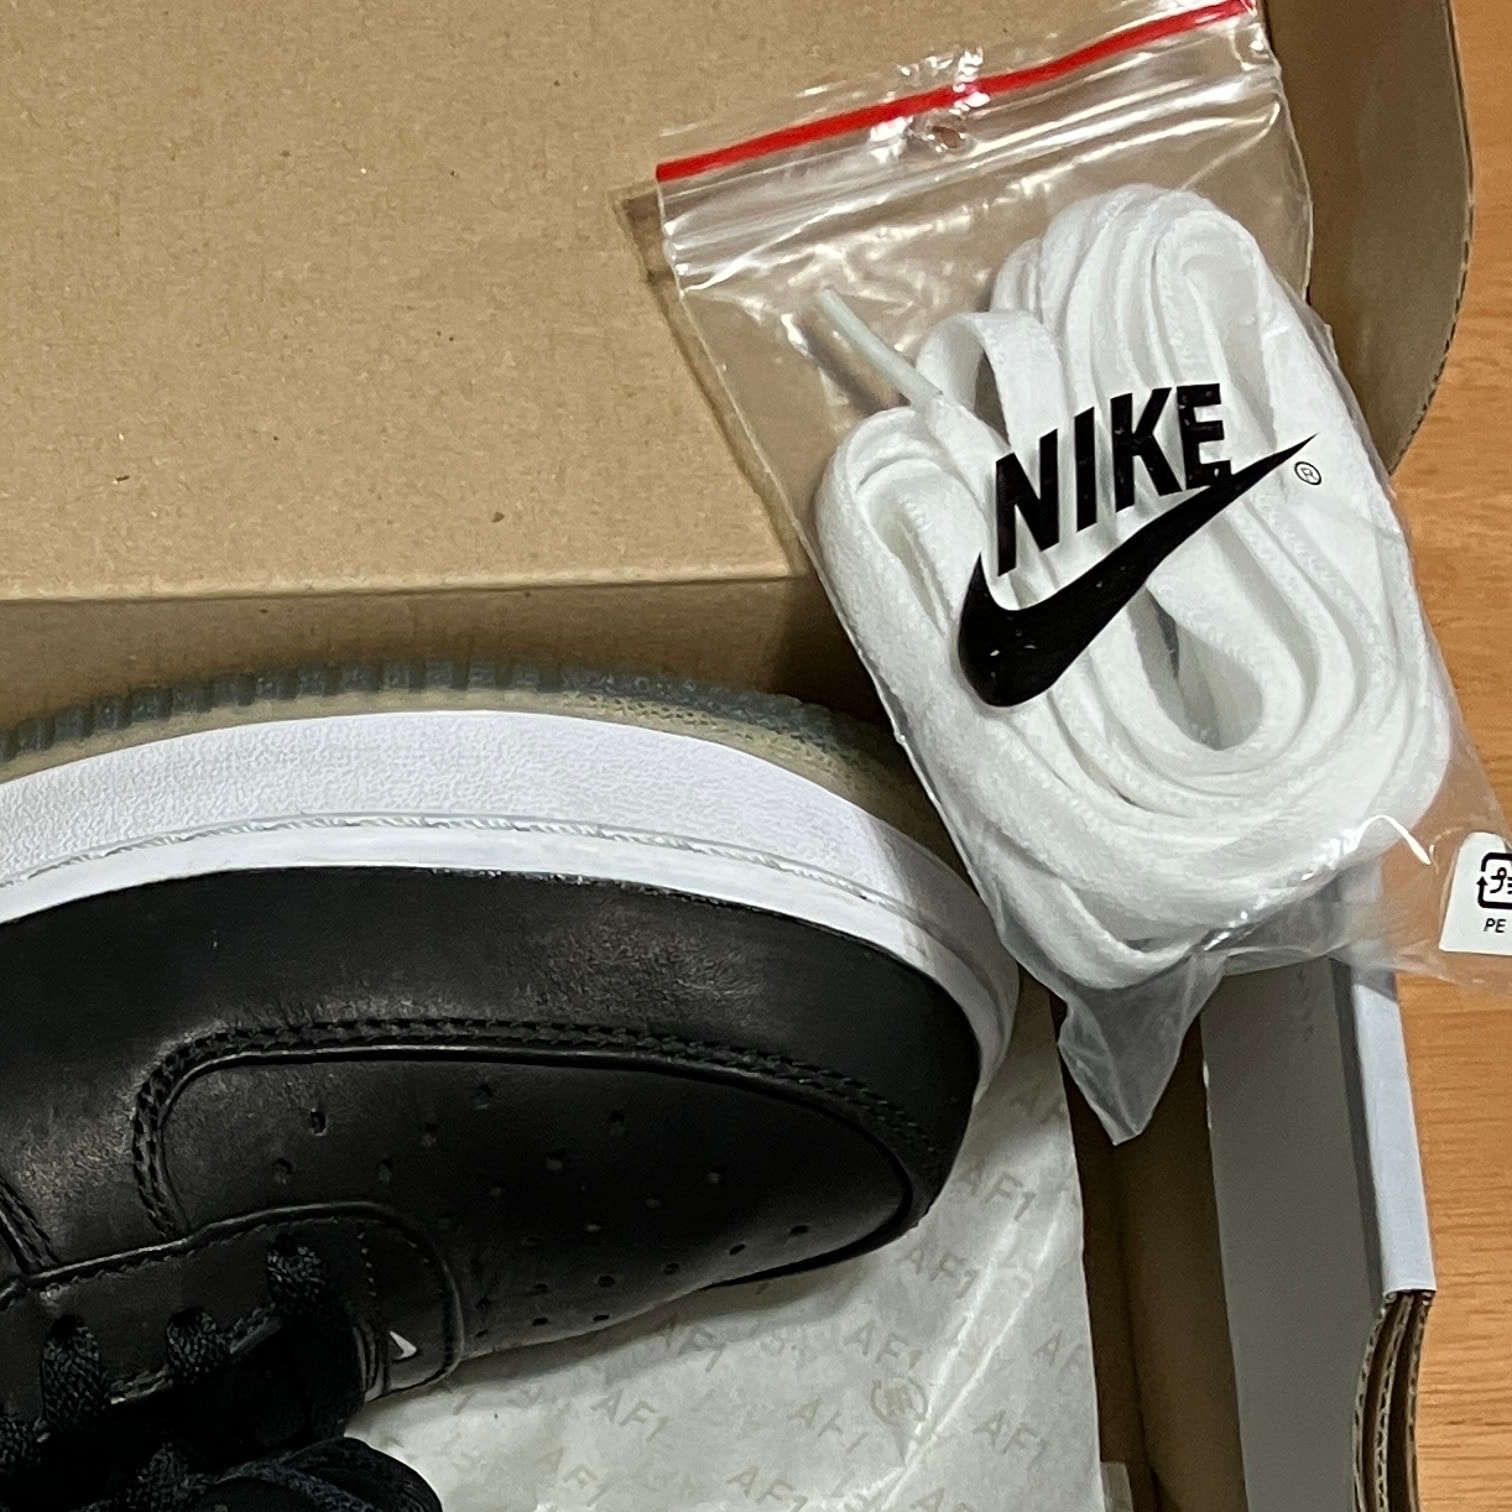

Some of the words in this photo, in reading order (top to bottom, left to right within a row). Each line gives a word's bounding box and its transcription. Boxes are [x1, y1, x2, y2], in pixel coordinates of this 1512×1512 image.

[995, 383, 1231, 576] NIKE
[1483, 917, 1506, 933] PE
[900, 1236, 980, 1300] AF1
[842, 1319, 926, 1370] AF1
[1031, 1329, 1089, 1378] AF
[590, 1387, 669, 1444] AF1
[973, 1409, 1049, 1471] AF1
